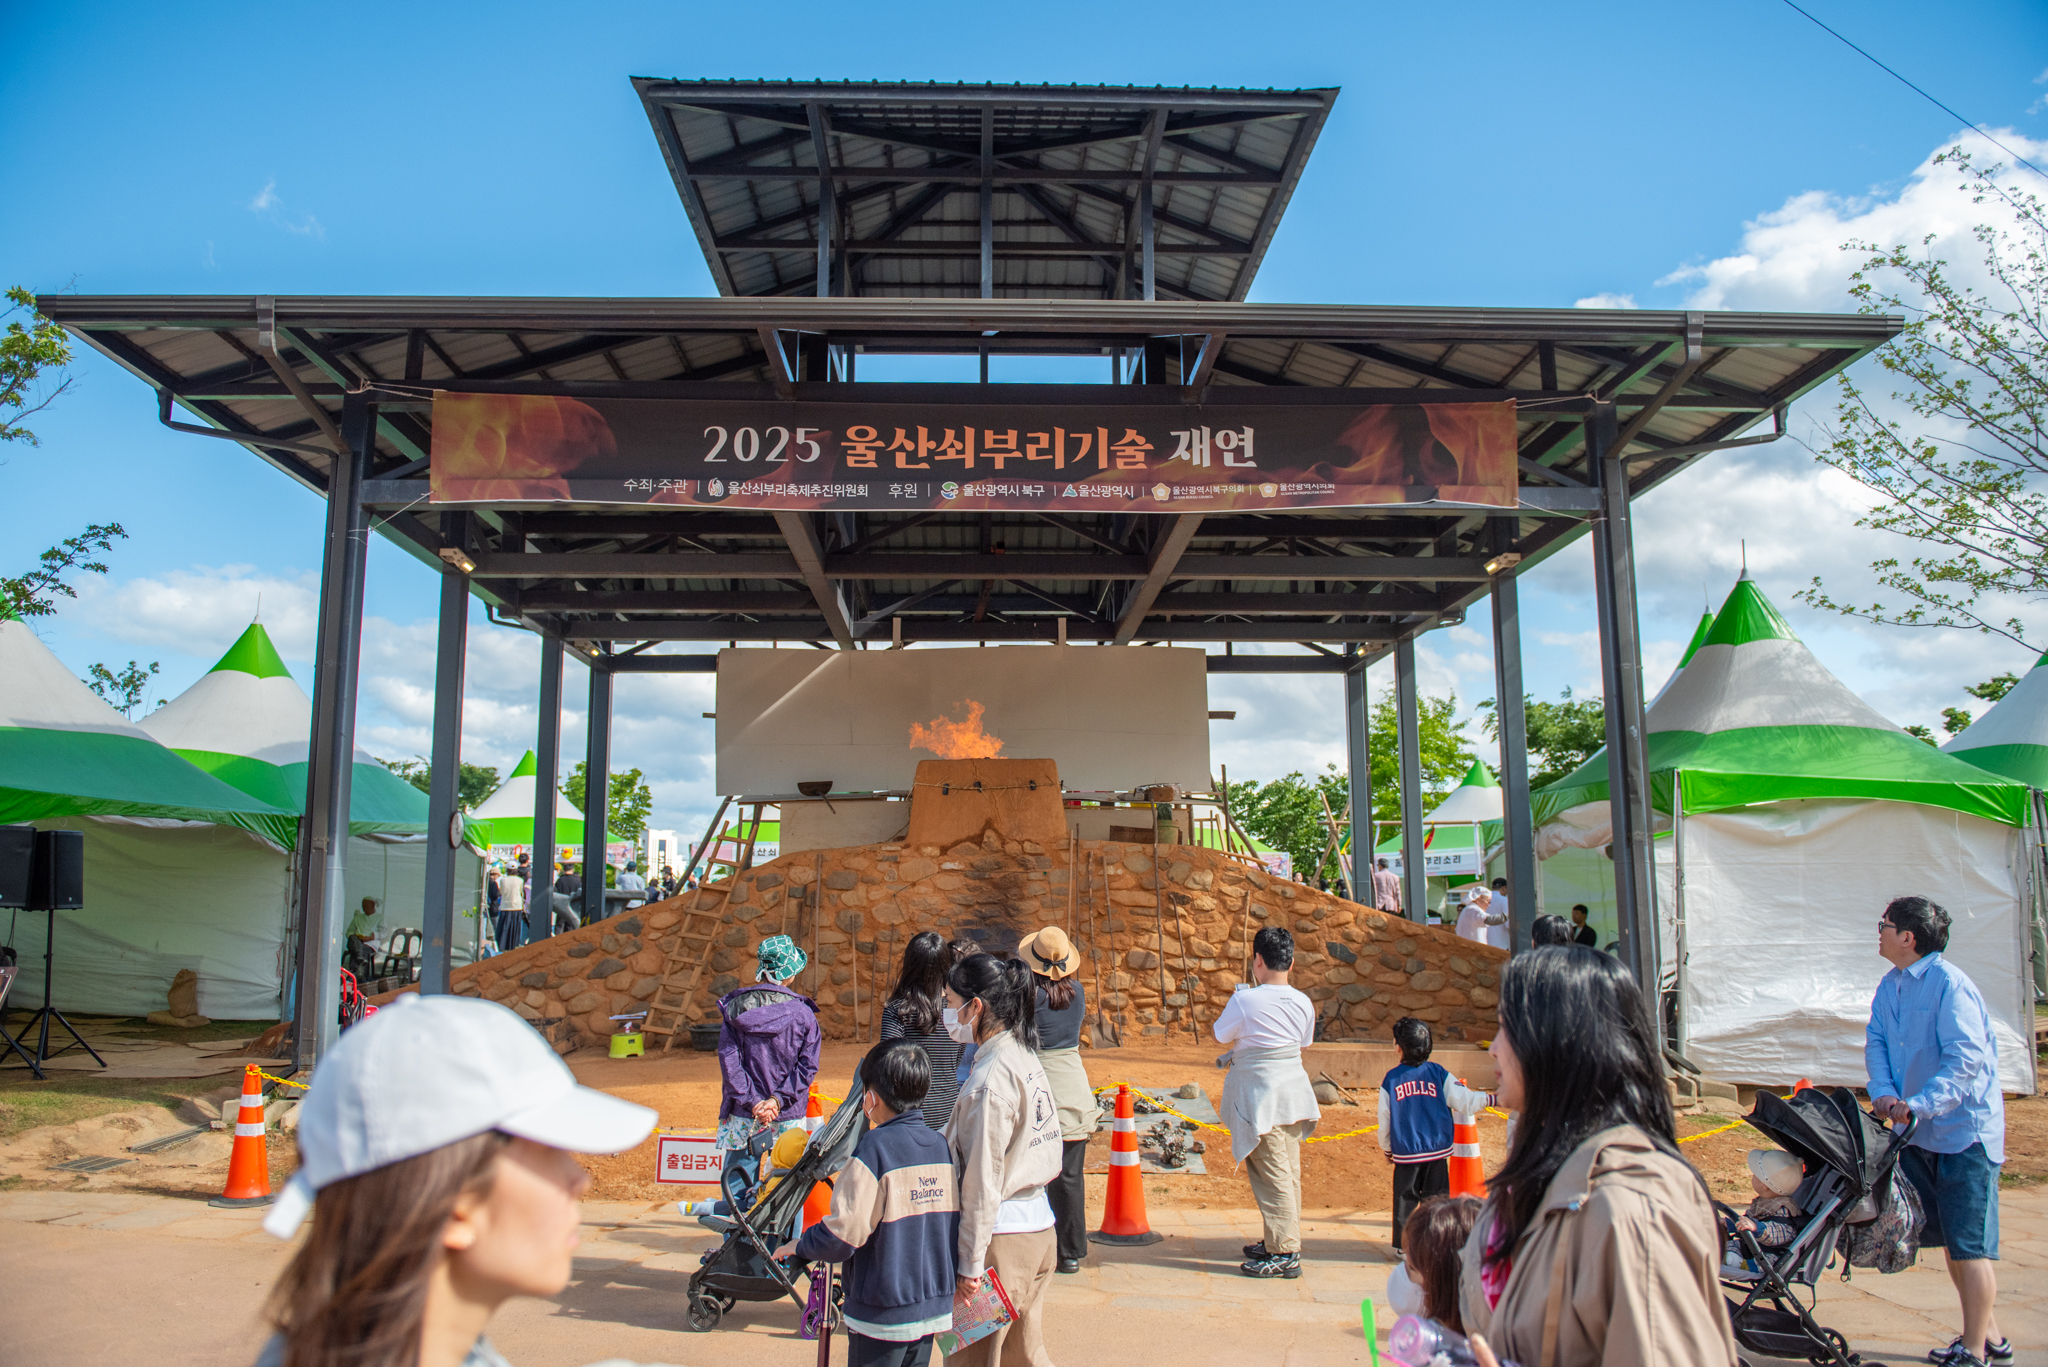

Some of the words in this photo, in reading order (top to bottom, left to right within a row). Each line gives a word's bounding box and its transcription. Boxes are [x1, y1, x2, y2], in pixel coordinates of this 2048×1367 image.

[704, 426, 821, 463] 2025
[841, 425, 1155, 470] 울산쇠부리기술
[1168, 425, 1258, 470] 재연
[728, 481, 868, 497] 울산쇠부리축제추진위원회
[888, 483, 918, 499] 후원
[963, 485, 1019, 497] 울산광역시
[1022, 485, 1045, 497] 북구
[1078, 485, 1134, 498] 울산광역시
[1395, 1080, 1437, 1101] BULLS
[667, 1153, 722, 1170] 출입금지
[918, 1176, 937, 1187] New
[910, 1188, 944, 1200] Balance
